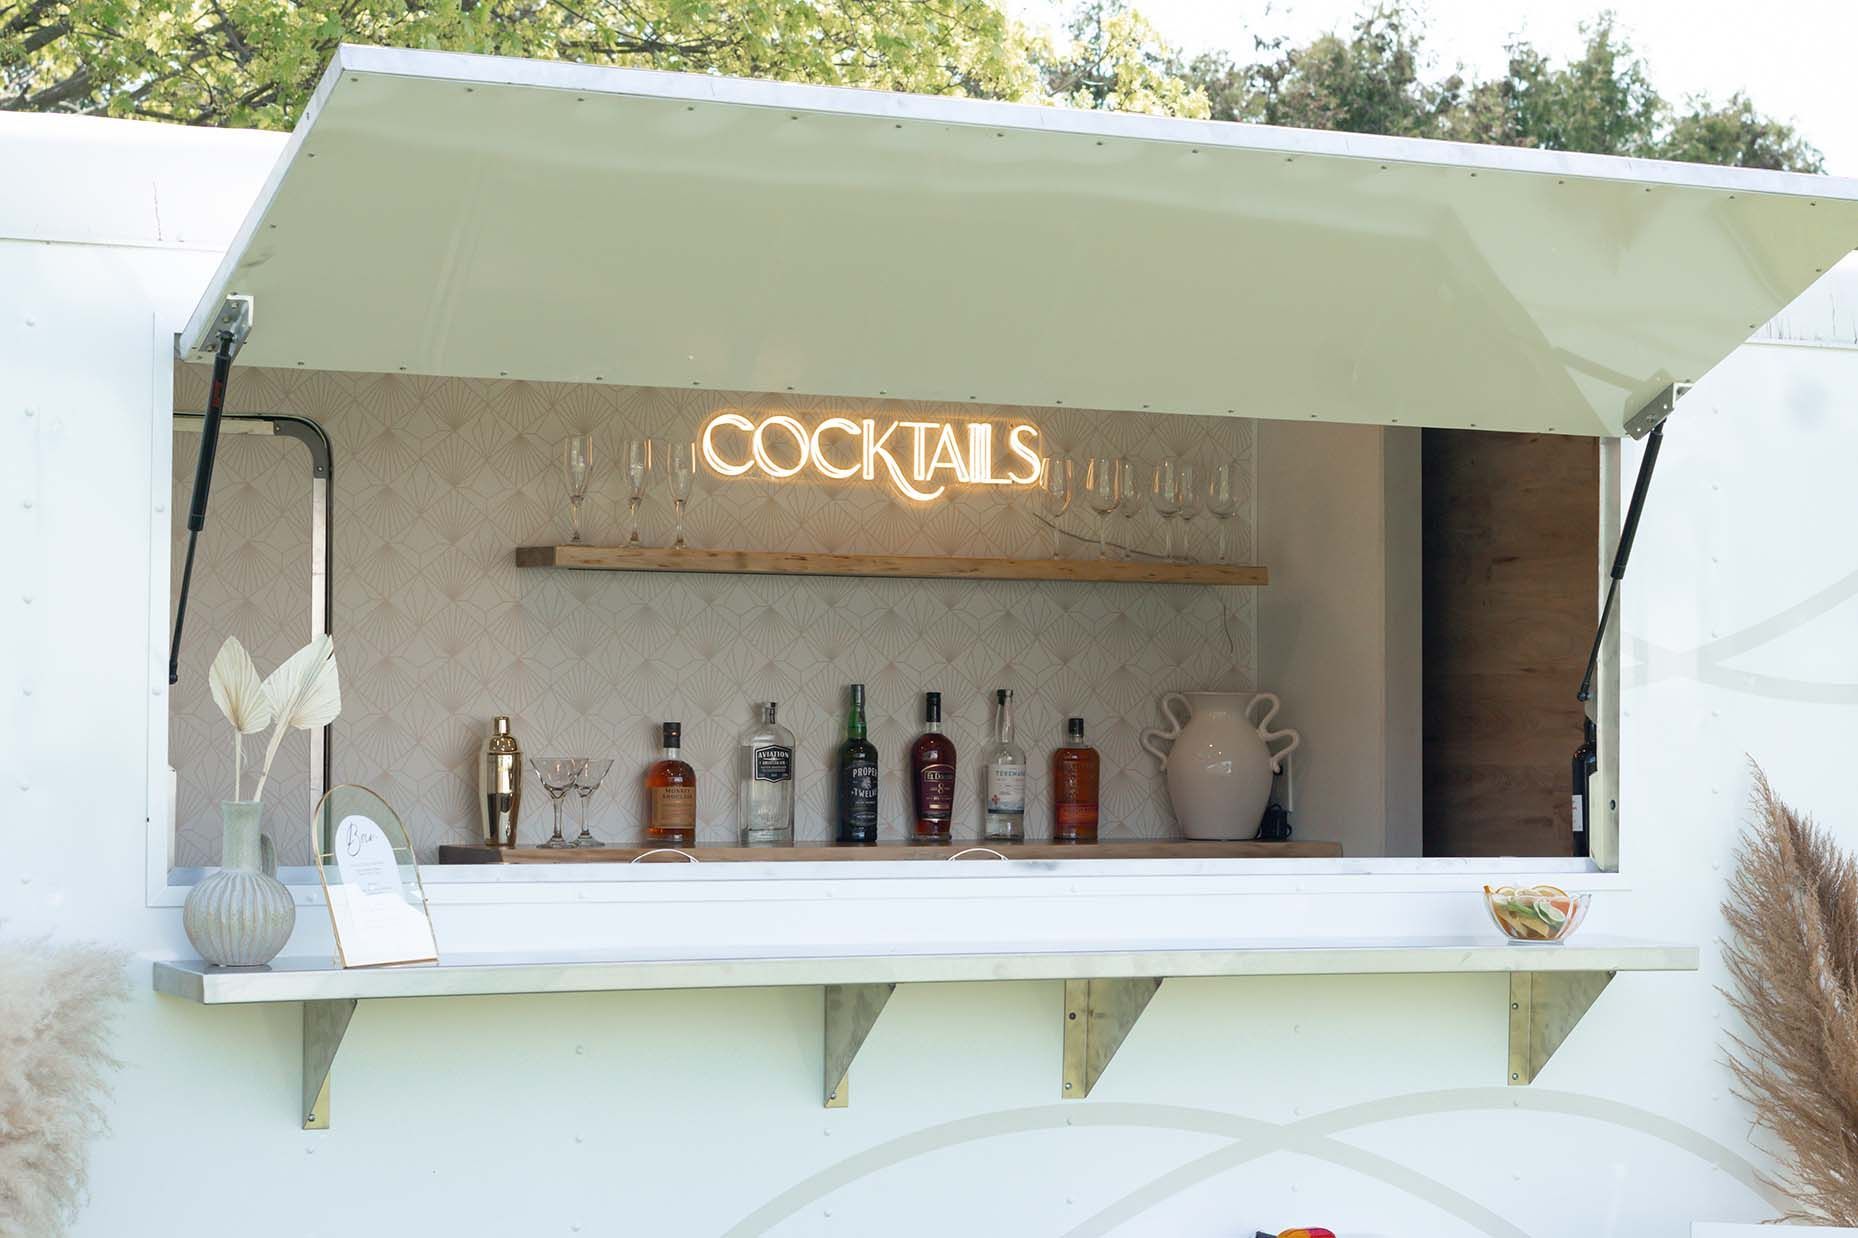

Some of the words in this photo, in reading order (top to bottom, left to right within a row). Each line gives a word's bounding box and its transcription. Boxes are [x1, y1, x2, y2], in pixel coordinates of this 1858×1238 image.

[702, 413, 1042, 501] COCKTAILS
[758, 751, 789, 759] AVIATION
[854, 787, 877, 798] TWEL
